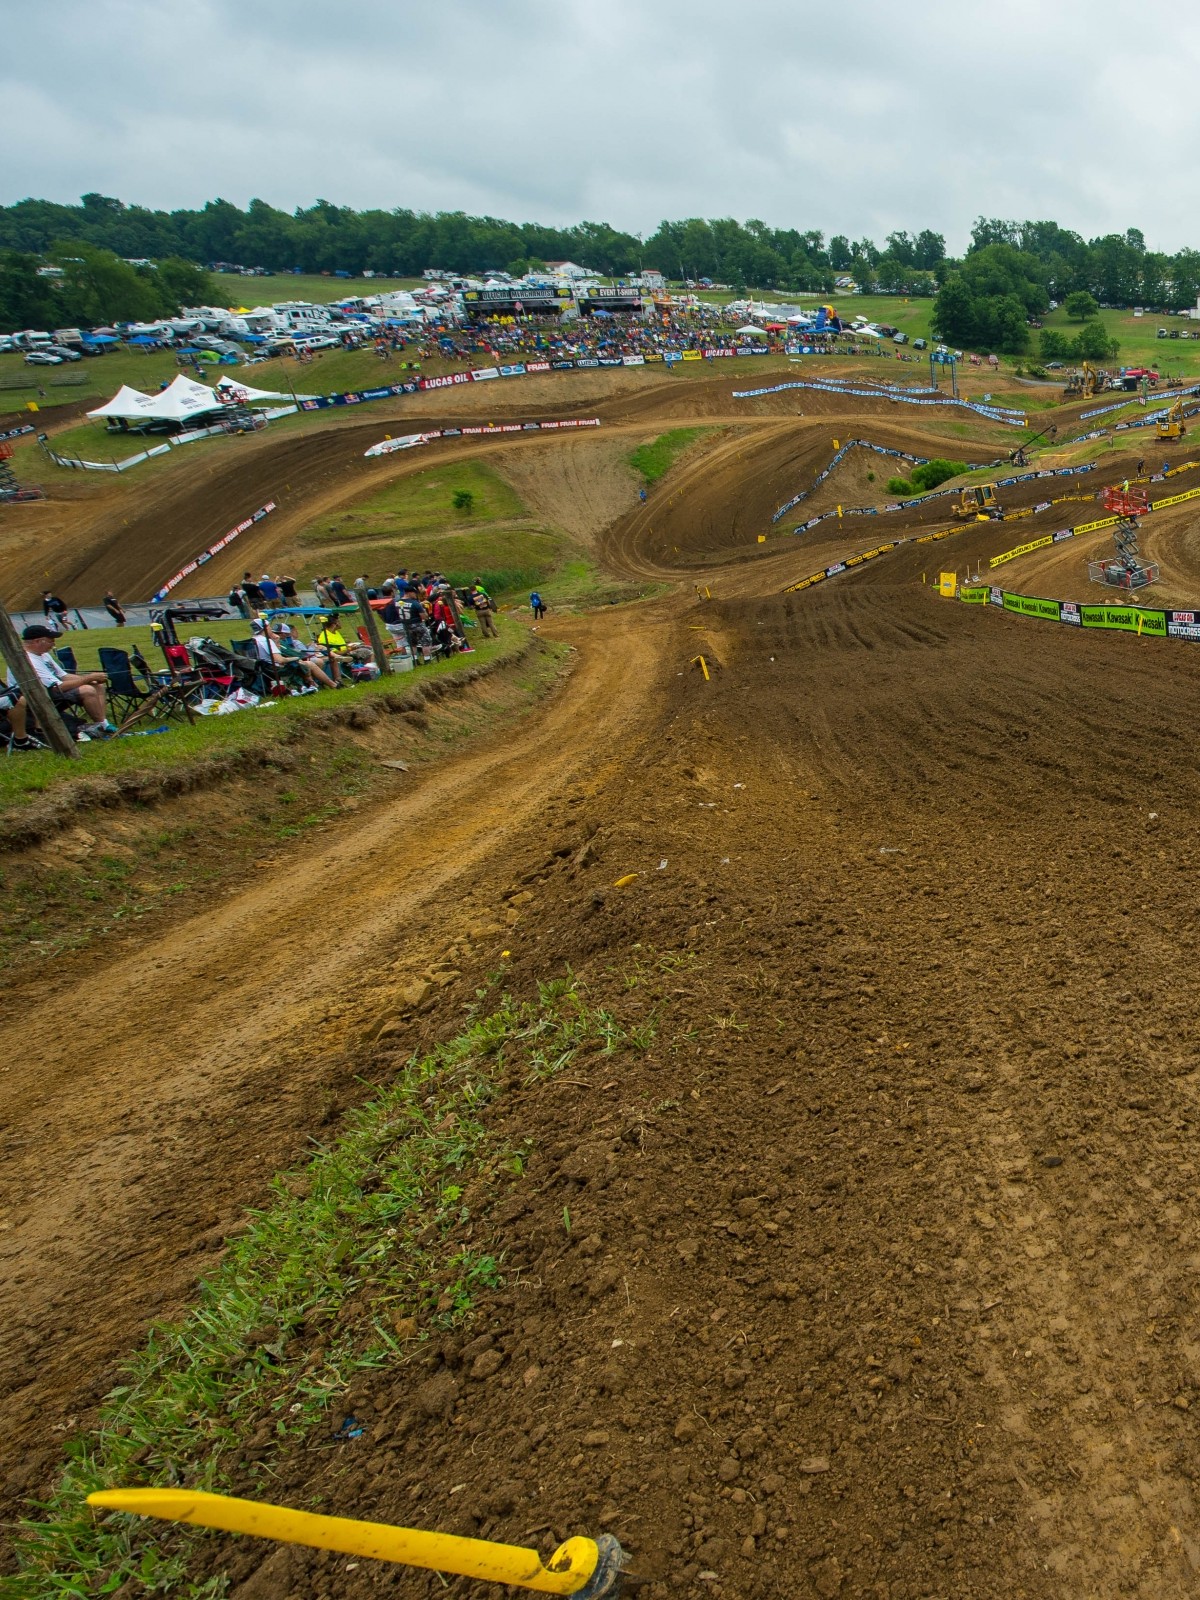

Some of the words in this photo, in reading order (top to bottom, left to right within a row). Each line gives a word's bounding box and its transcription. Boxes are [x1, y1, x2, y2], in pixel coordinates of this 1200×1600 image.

[600, 289, 617, 297] EVENT
[705, 349, 724, 357] LUCAS
[527, 363, 550, 372] FRAM
[425, 375, 453, 389] LUCAS
[454, 373, 469, 384] OIL
[1153, 497, 1172, 509] SUZUKI
[1074, 524, 1095, 534] SUZUKI
[210, 540, 225, 556] FRAM
[224, 529, 239, 544] FRAM
[237, 518, 253, 533] FRAM
[1011, 545, 1032, 557] SUZUKI
[1032, 537, 1052, 549] SUZUKI
[167, 573, 183, 589] FRAM
[182, 561, 198, 577] FRAM
[1106, 611, 1133, 625] Kawasaki
